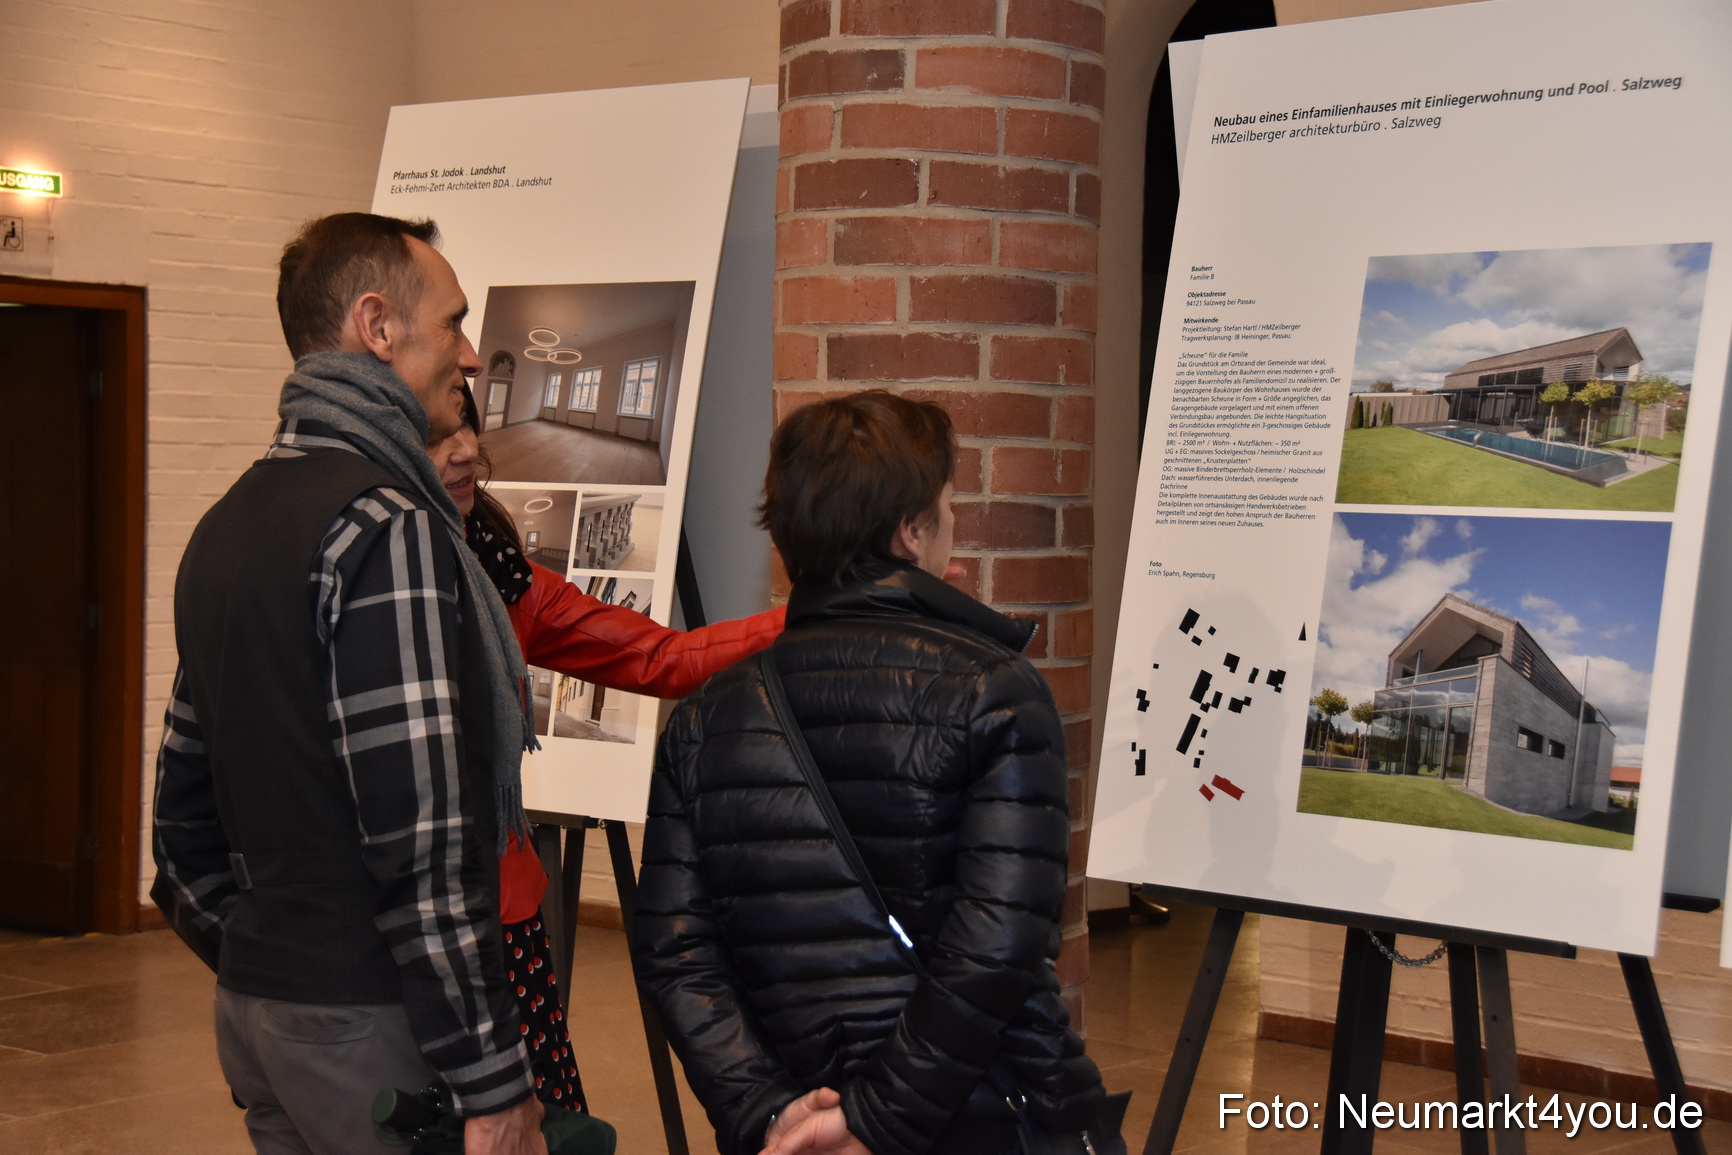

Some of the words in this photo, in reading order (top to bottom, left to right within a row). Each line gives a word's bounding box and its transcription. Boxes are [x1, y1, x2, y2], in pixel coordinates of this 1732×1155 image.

[1214, 114, 1256, 127] Neubau
[1259, 112, 1289, 123] eines
[1291, 102, 1397, 120] Einfamilienhauses
[1401, 98, 1422, 110] mit
[1425, 89, 1544, 108] Einliegerwohnung
[1548, 83, 1575, 97] und
[1579, 80, 1609, 95] Pool
[1622, 77, 1682, 91] Salzweg
[1211, 130, 1287, 145] HMZeilberger
[1289, 121, 1381, 138] architekturbüro
[1391, 117, 1442, 130] Salzweg
[393, 170, 429, 180] Pfarrhaus
[430, 169, 440, 178] St.
[441, 167, 464, 178] Jodok
[471, 165, 506, 176] Landshut
[0, 172, 54, 191] USGANG
[391, 183, 445, 194] Eck-Fehmi-Zett
[446, 180, 491, 191] Architekten
[493, 179, 510, 189] BDA
[516, 176, 553, 187] Landshut
[1188, 291, 1227, 299] Objektadresse
[1182, 326, 1223, 334] Projektleitung:
[1182, 335, 1233, 343] Tragwerksplanung:
[1319, 368, 1336, 376] groß-
[1175, 379, 1197, 387] zügigen
[1282, 395, 1319, 403] angeglichen,
[1171, 405, 1218, 413] Garagengebäude
[1285, 413, 1327, 421] Hangsituation
[1217, 422, 1251, 430] ermöglichte
[1262, 422, 1303, 430] 3-geschossiges
[1180, 431, 1231, 439] Einliegerwohnung.
[1215, 449, 1256, 457] Sockelgeschoss
[1164, 457, 1202, 465] geschnittenen
[1257, 476, 1299, 484] innenliegende
[1169, 492, 1198, 500] komplette
[1198, 493, 1247, 502] Innenausstattung
[1205, 502, 1246, 510] ortsansässigen
[1199, 511, 1213, 519] zeigt
[1163, 570, 1181, 578] Spahn,
[1182, 571, 1216, 580] Regensburg
